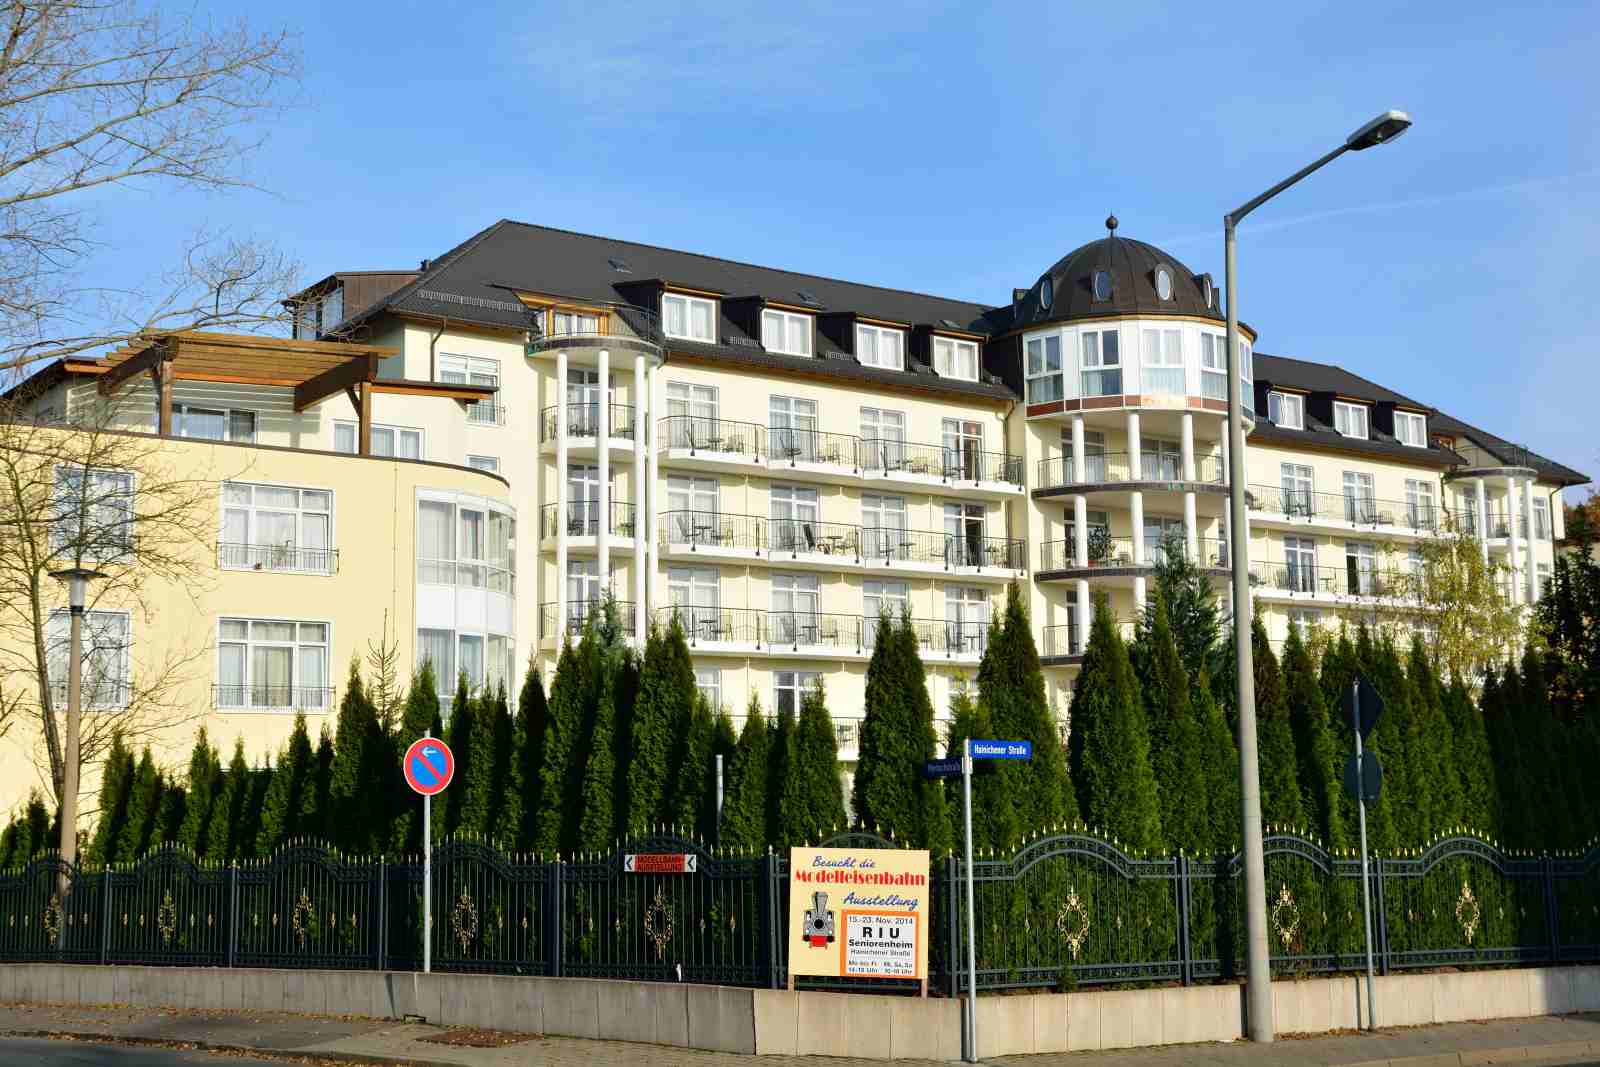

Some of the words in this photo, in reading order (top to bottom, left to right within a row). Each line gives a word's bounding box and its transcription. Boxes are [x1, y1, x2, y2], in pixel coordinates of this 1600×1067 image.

[1008, 745, 1026, 755] Straße
[812, 856, 857, 868] Besucht
[859, 858, 876, 868] die
[795, 869, 926, 886] Modelleisenbahn
[843, 892, 919, 912] Ausstellung
[895, 917, 913, 925] 2014
[849, 939, 913, 949] Seniorenheim
